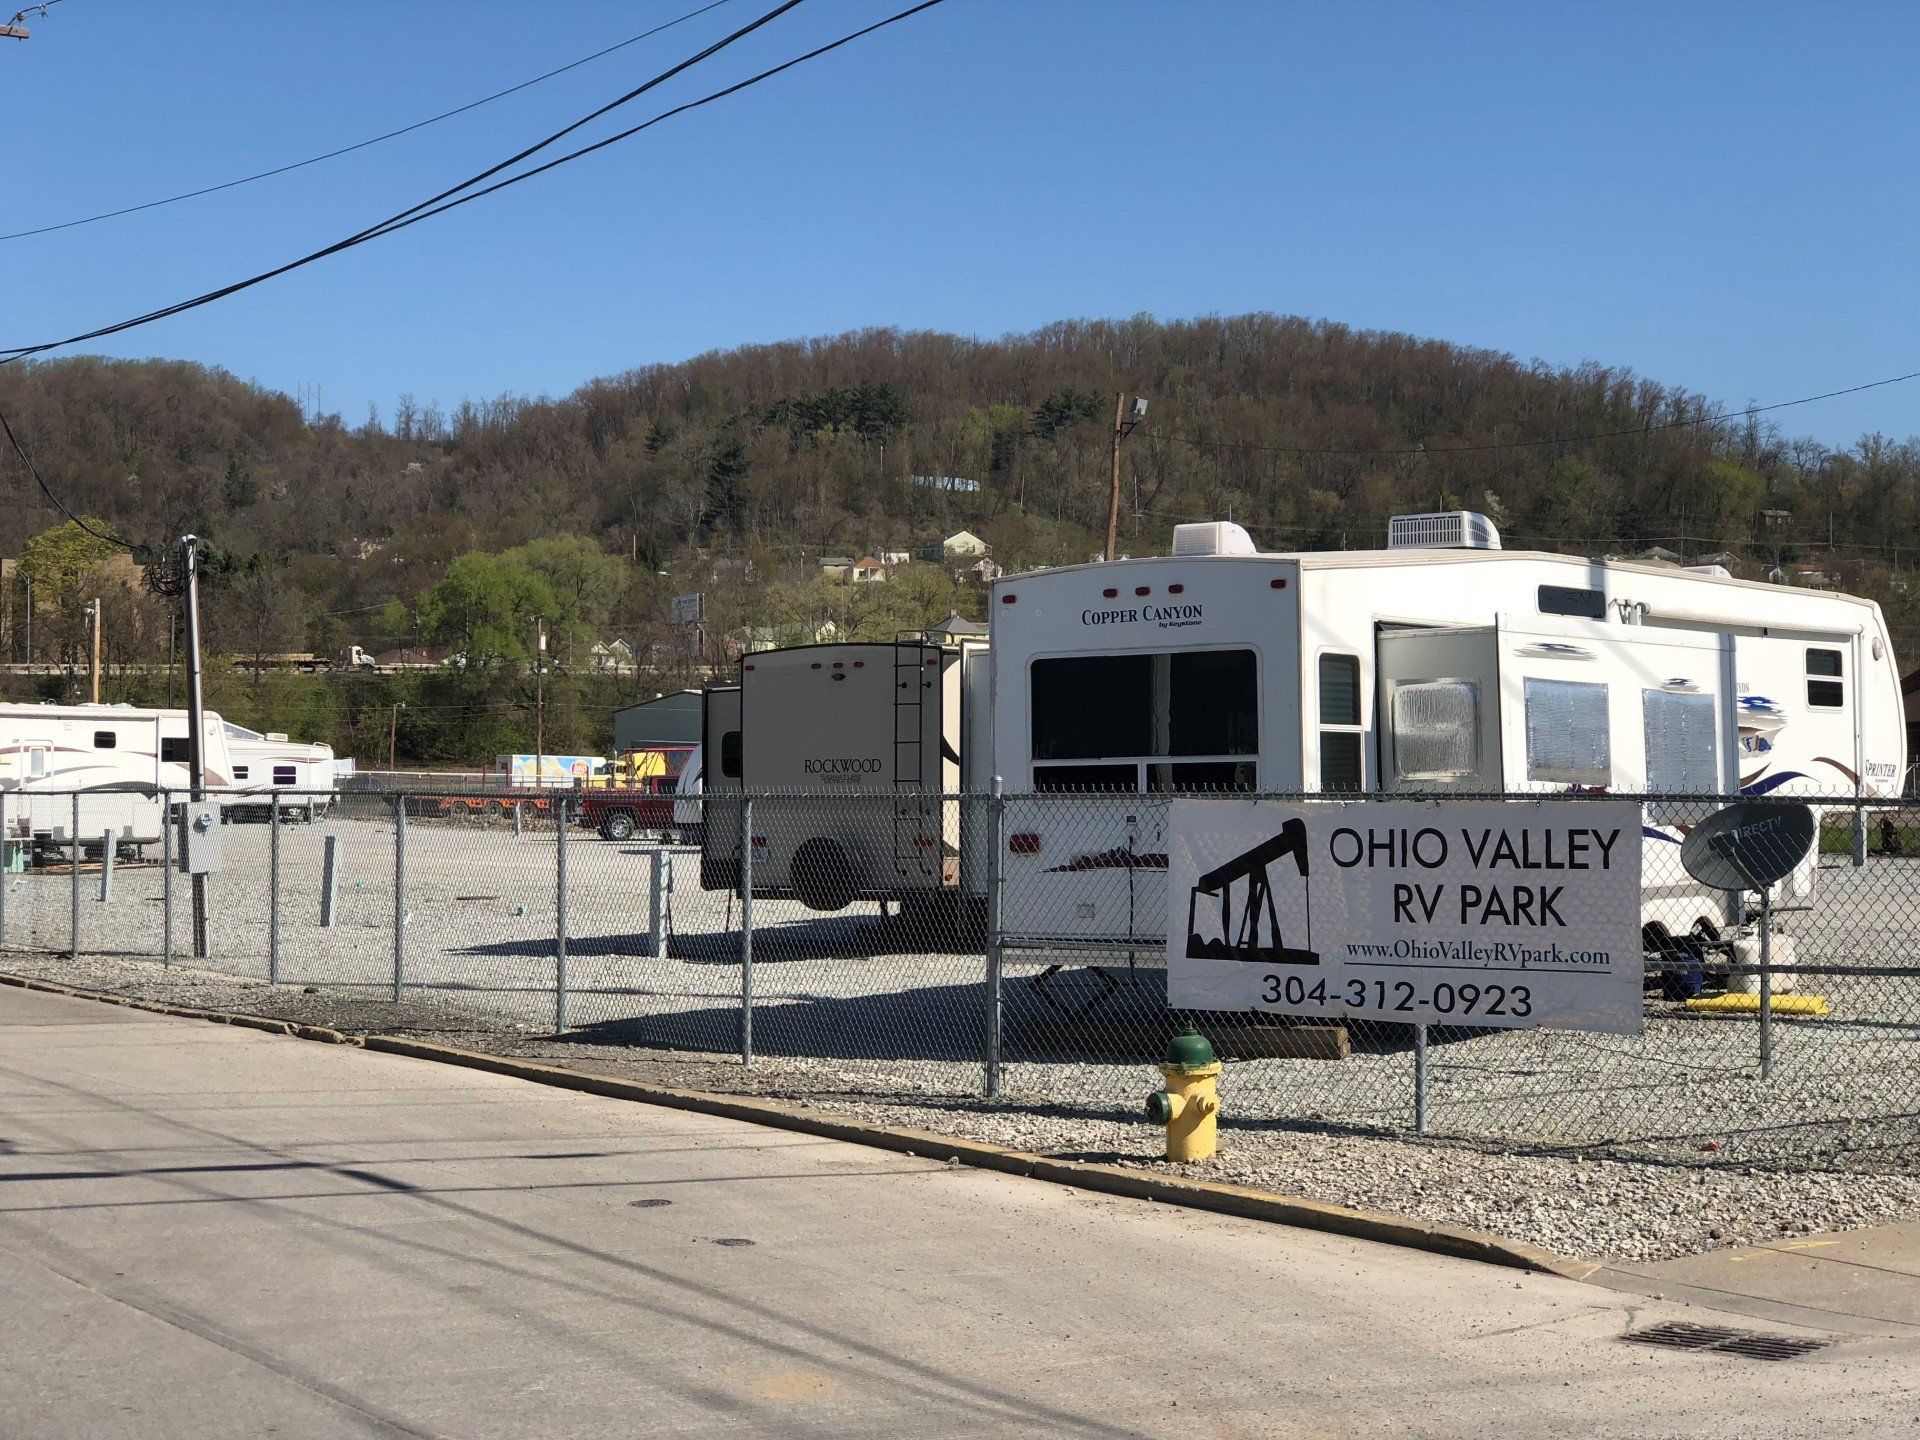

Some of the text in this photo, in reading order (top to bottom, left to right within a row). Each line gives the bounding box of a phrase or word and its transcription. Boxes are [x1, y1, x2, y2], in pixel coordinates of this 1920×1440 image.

[1081, 605, 1203, 625] COPPER CANYON
[804, 758, 882, 773] ROCKWOOD
[1738, 816, 1781, 839] IRECTV
[1329, 827, 1621, 870] OHIO VALLEY
[1393, 883, 1568, 927] RV PARK
[1346, 939, 1611, 968] www.OhioValleyRVpark.com
[1261, 974, 1533, 1017] 304-312-0923
